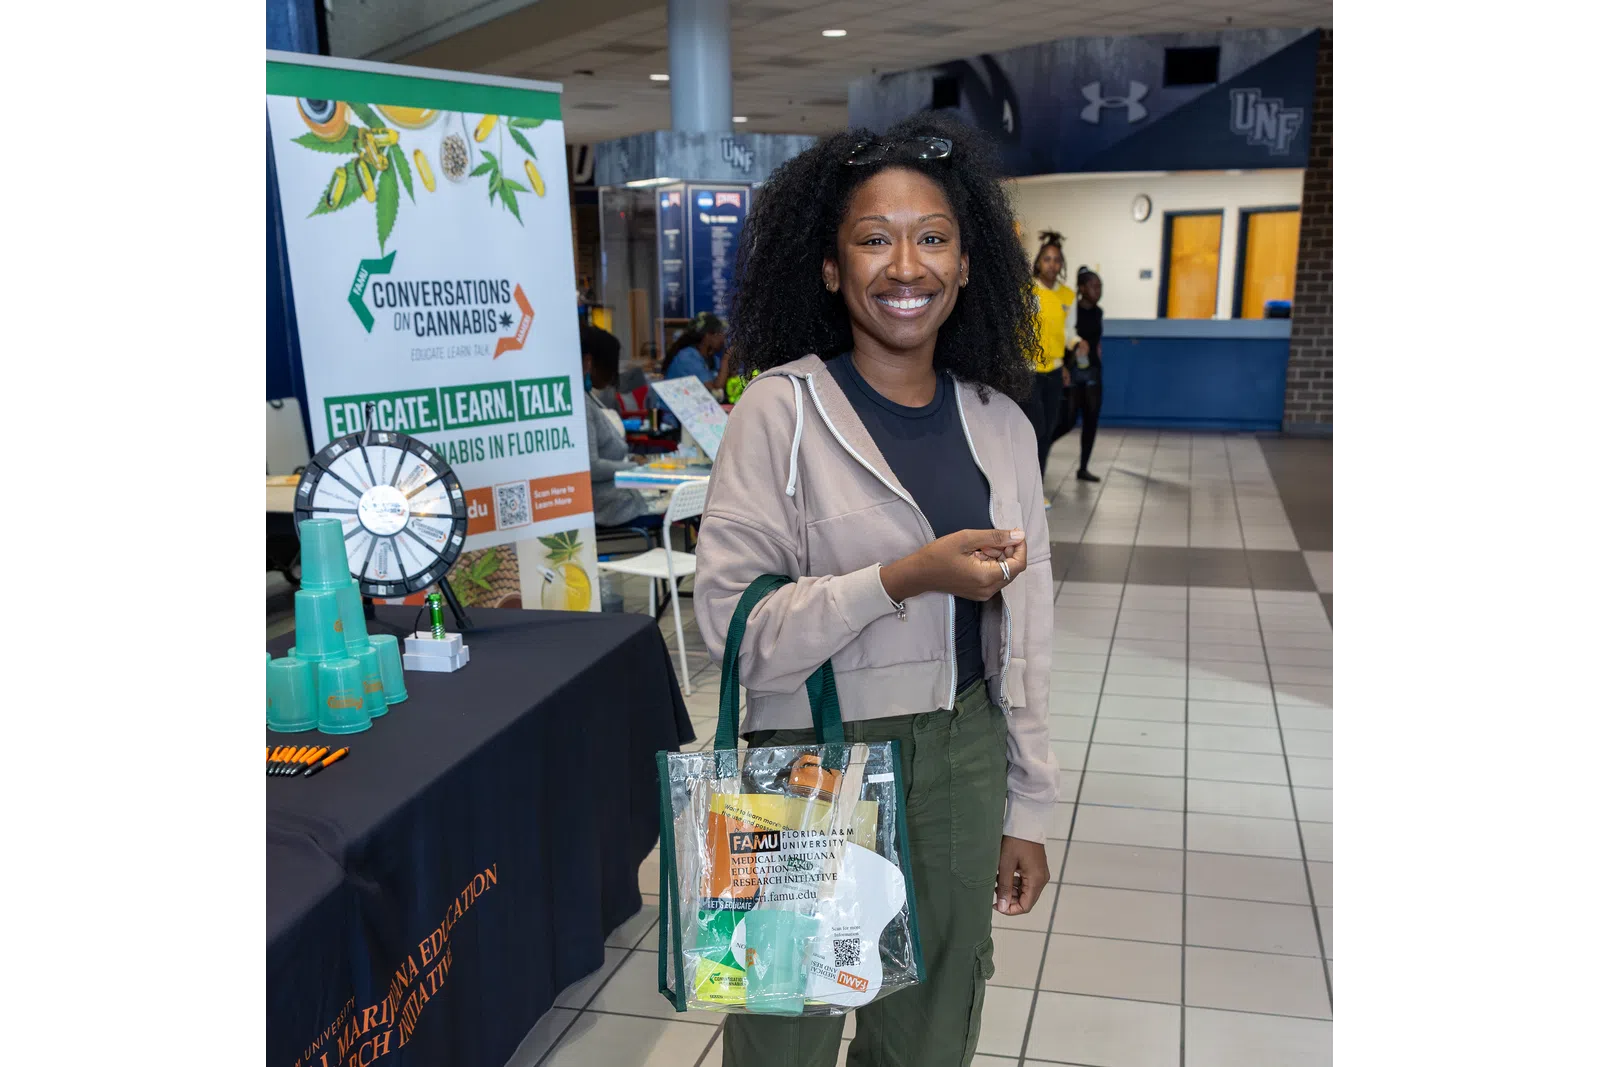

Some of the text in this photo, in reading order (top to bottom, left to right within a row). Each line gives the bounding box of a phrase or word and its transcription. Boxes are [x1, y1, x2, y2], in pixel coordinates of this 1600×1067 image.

[1229, 87, 1304, 156] UNF
[721, 138, 755, 174] UNF
[372, 279, 511, 308] CONVERSATIONS
[394, 309, 497, 337] ON CANNABIS
[443, 386, 513, 425] LEARN.
[519, 381, 572, 416] TALK.
[488, 434, 505, 459] IN
[507, 426, 575, 456] FLORIDA.
[534, 485, 575, 498] Scan Here to
[535, 498, 573, 510] Learn More
[725, 803, 740, 813] Want
[732, 828, 854, 852] FAMU FLORIDA A&M
[782, 839, 844, 849] UNIVERSITY
[731, 852, 836, 865] MEDICAL MARIJUANA
[732, 864, 814, 876] EDUCATION AND
[733, 873, 838, 887] RESEARCH INITIATIVE
[337, 863, 498, 1066] MARIJUANA EDUCATION
[839, 973, 867, 990] FAMU
[304, 995, 355, 1061] UNIVERSITY
